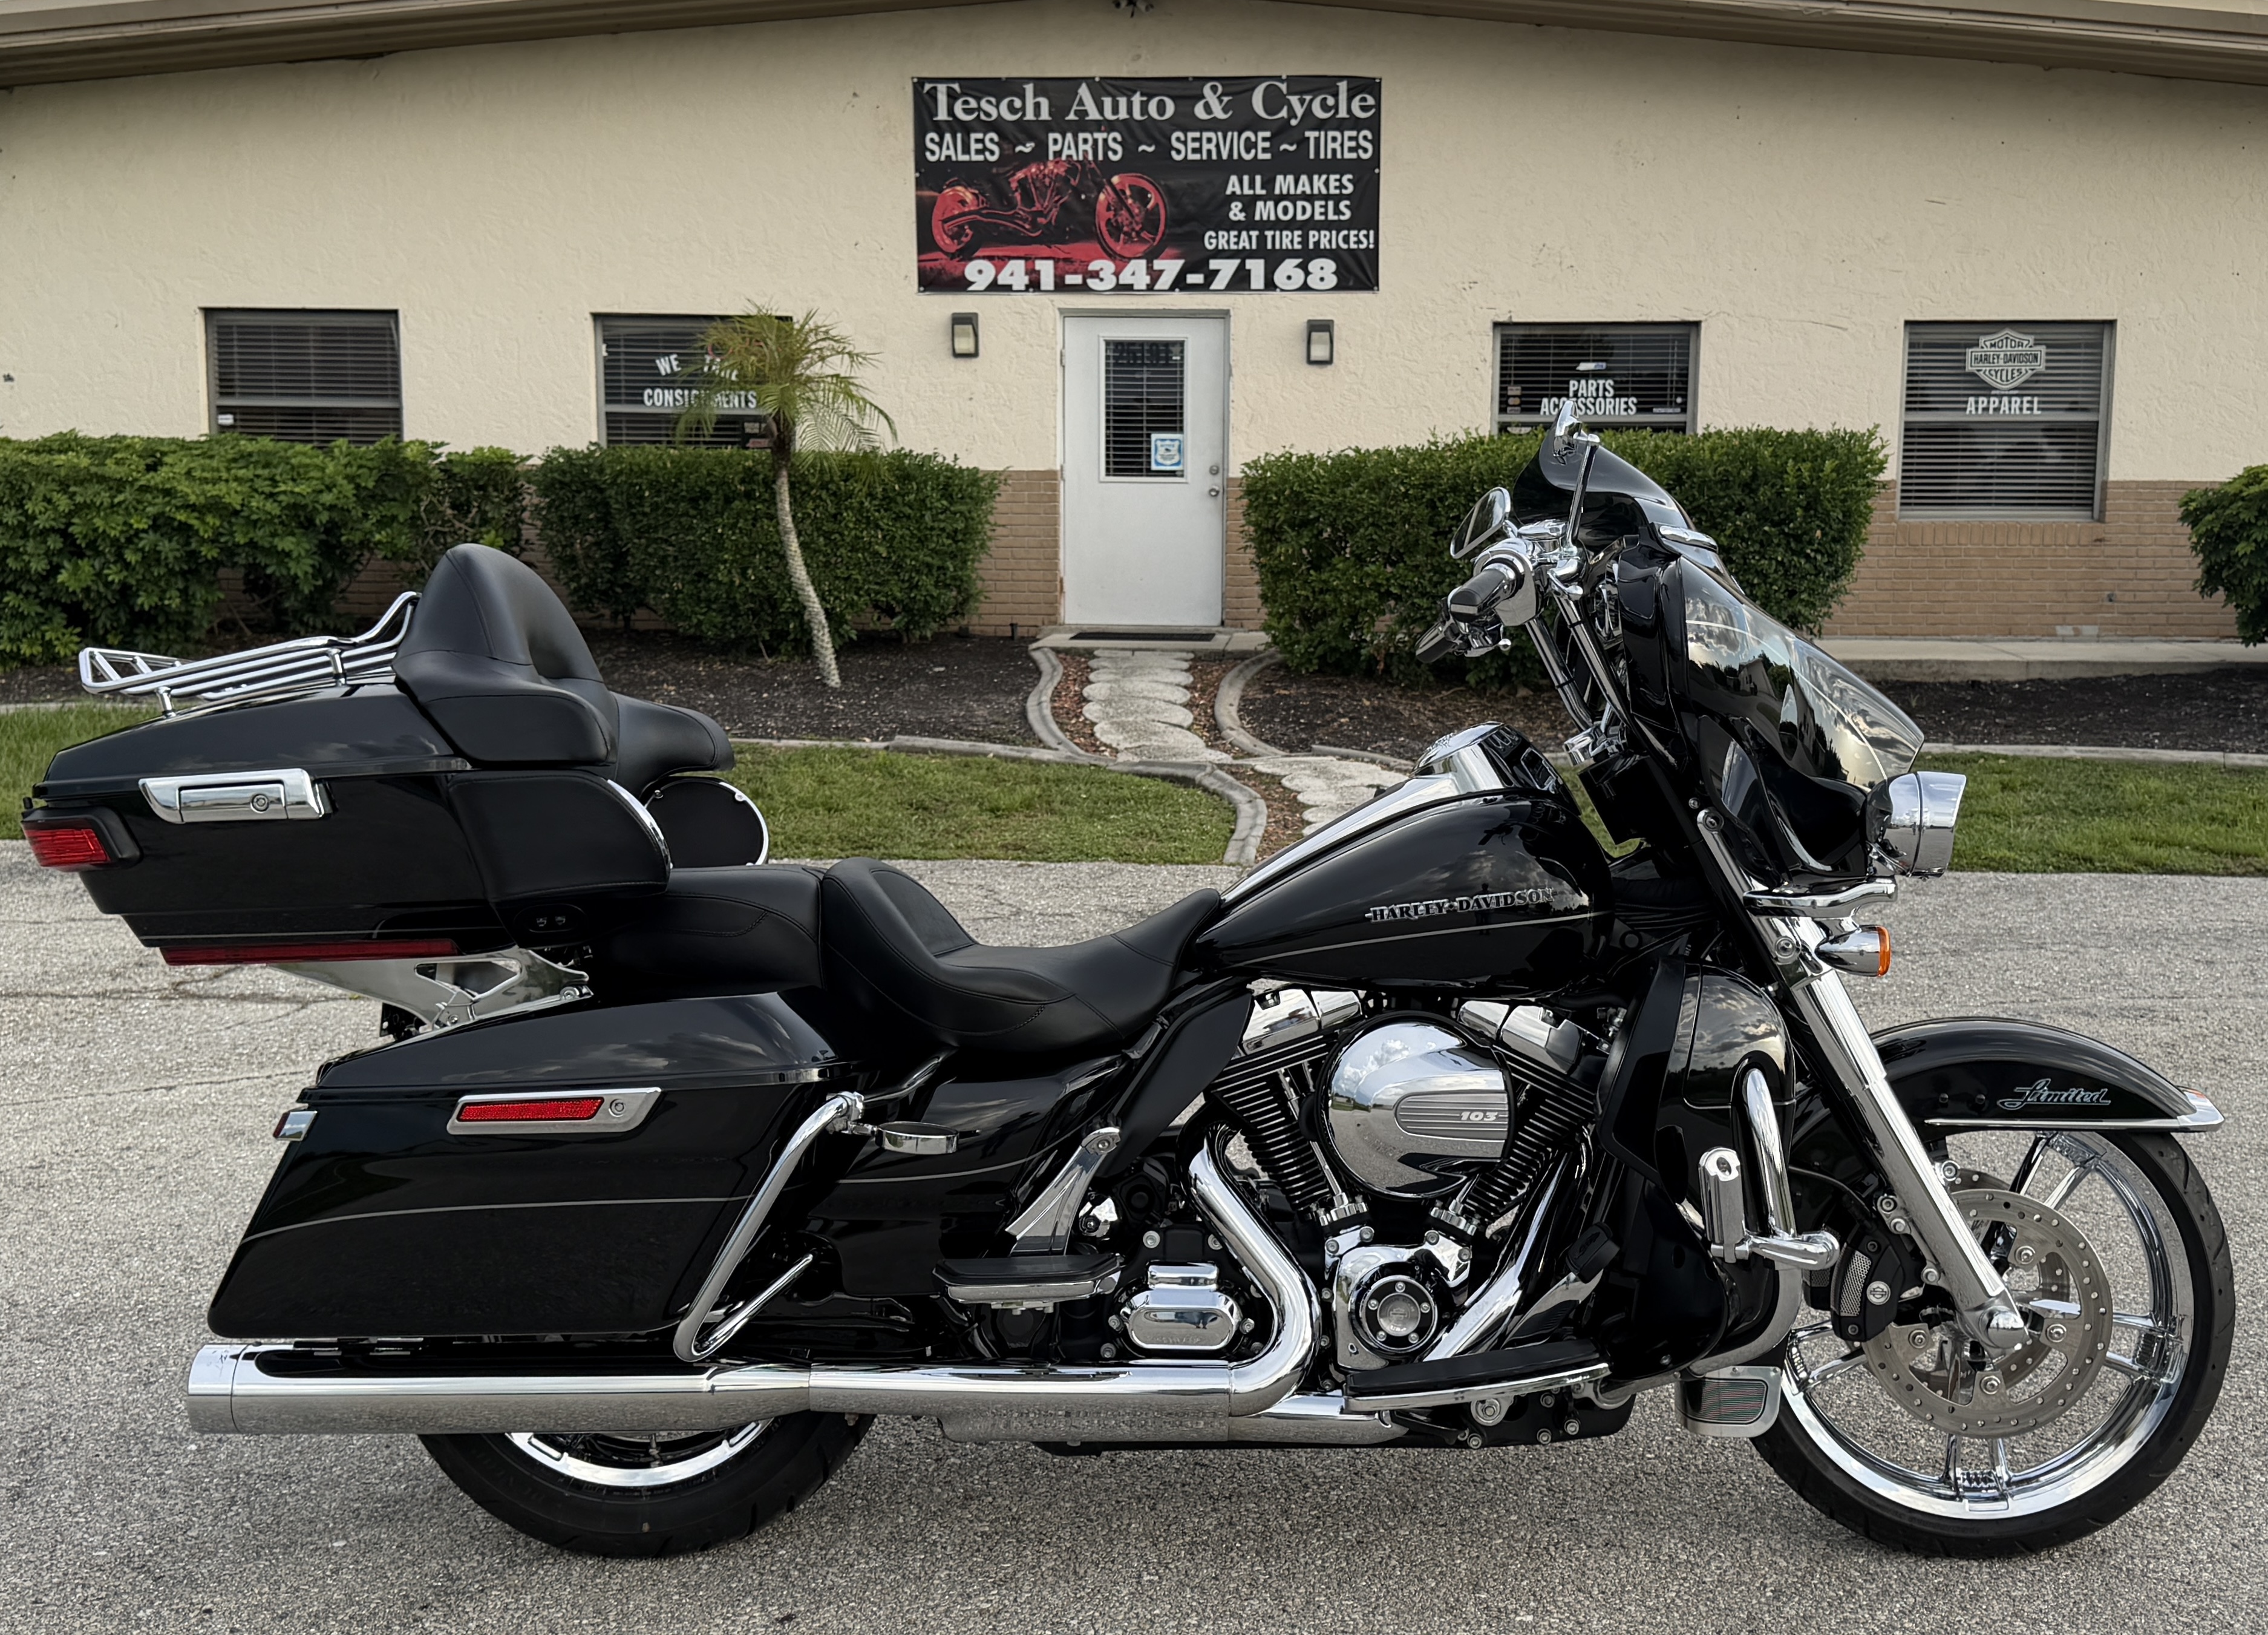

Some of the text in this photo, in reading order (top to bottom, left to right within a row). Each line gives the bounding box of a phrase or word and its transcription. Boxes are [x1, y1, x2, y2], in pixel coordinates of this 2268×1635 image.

[923, 80, 1376, 126] Tesch Auto & Cycle
[925, 132, 1000, 162] SALES
[1048, 132, 1123, 162] PARTS
[1171, 131, 1272, 161] SERVICE
[1304, 130, 1373, 160] TIRES
[1225, 174, 1355, 195] ALL MAKES
[1229, 200, 1351, 221] & MODELS
[1204, 229, 1375, 251] GREAT TIRE PRICES!
[964, 258, 1339, 292] 941-347-7168
[1989, 336, 2024, 349] MOTOR
[655, 353, 682, 376] WE
[1988, 368, 2023, 382] CYCLES
[1569, 379, 1615, 398] PARTS
[1966, 396, 2042, 414] APPAREL
[1997, 1078, 2111, 1110] Limited
[1460, 1111, 1498, 1121] 103
